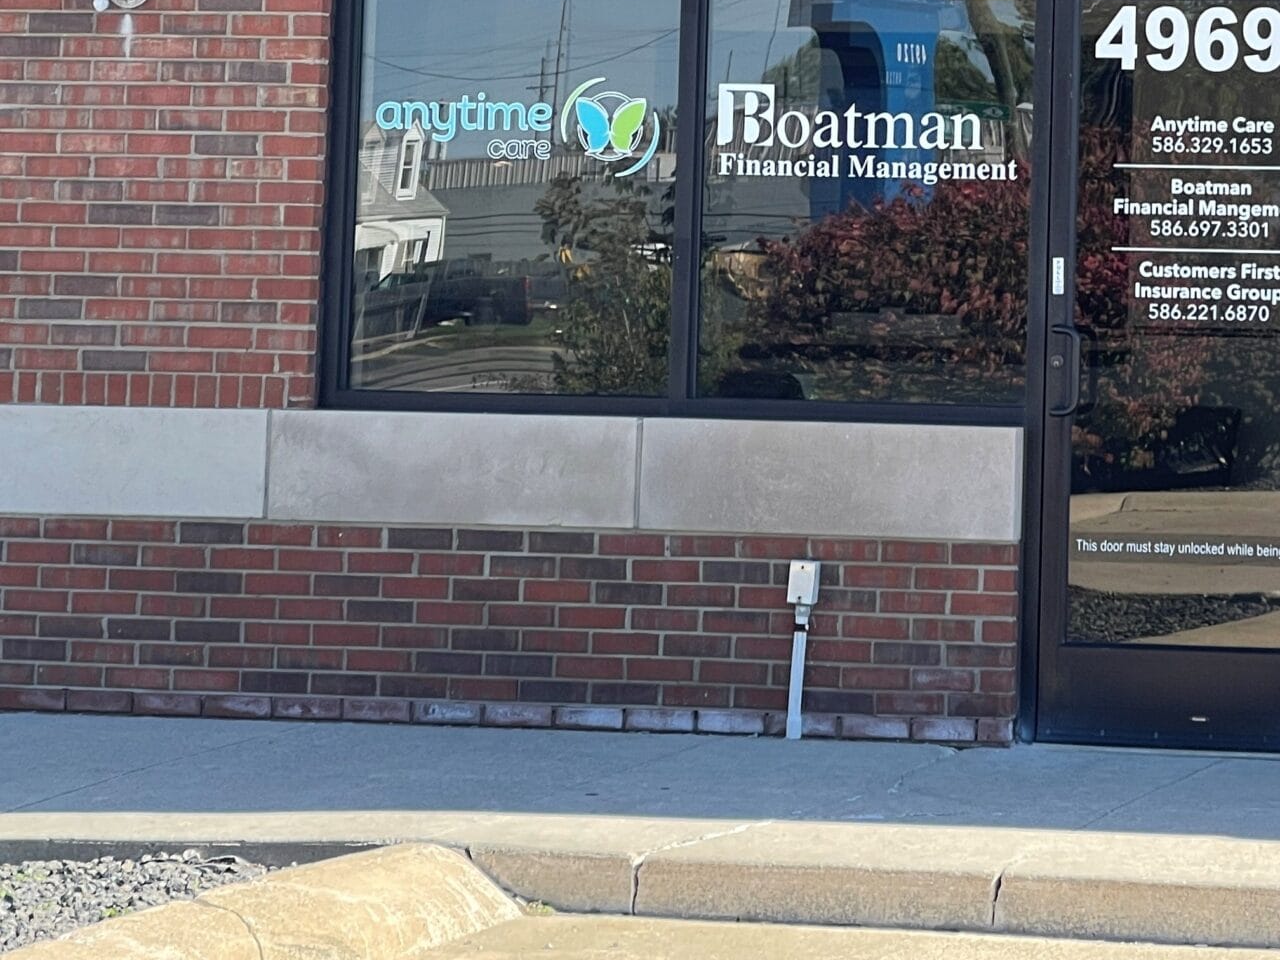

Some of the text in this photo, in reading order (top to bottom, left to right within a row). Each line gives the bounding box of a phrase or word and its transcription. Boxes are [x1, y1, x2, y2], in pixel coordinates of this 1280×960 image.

[375, 92, 552, 141] anytime
[716, 83, 985, 151] Boatman
[1151, 116, 1275, 136] Anytime Care
[487, 139, 551, 159] care
[1152, 137, 1273, 155] 586.329.1653
[717, 152, 1018, 185] Financial Management
[1171, 179, 1252, 196] Boatman
[1113, 198, 1194, 216] Financial
[1150, 220, 1269, 238] 586.697.3301
[1138, 261, 1280, 280] Customers First
[1134, 282, 1222, 301] Insurance
[1148, 304, 1270, 322] 586.221.6870
[1076, 539, 1098, 552] This
[1100, 539, 1124, 553] door
[1126, 541, 1152, 554] must
[1154, 542, 1175, 557] stay
[1178, 542, 1225, 556] unlocked
[1227, 543, 1254, 557] while
